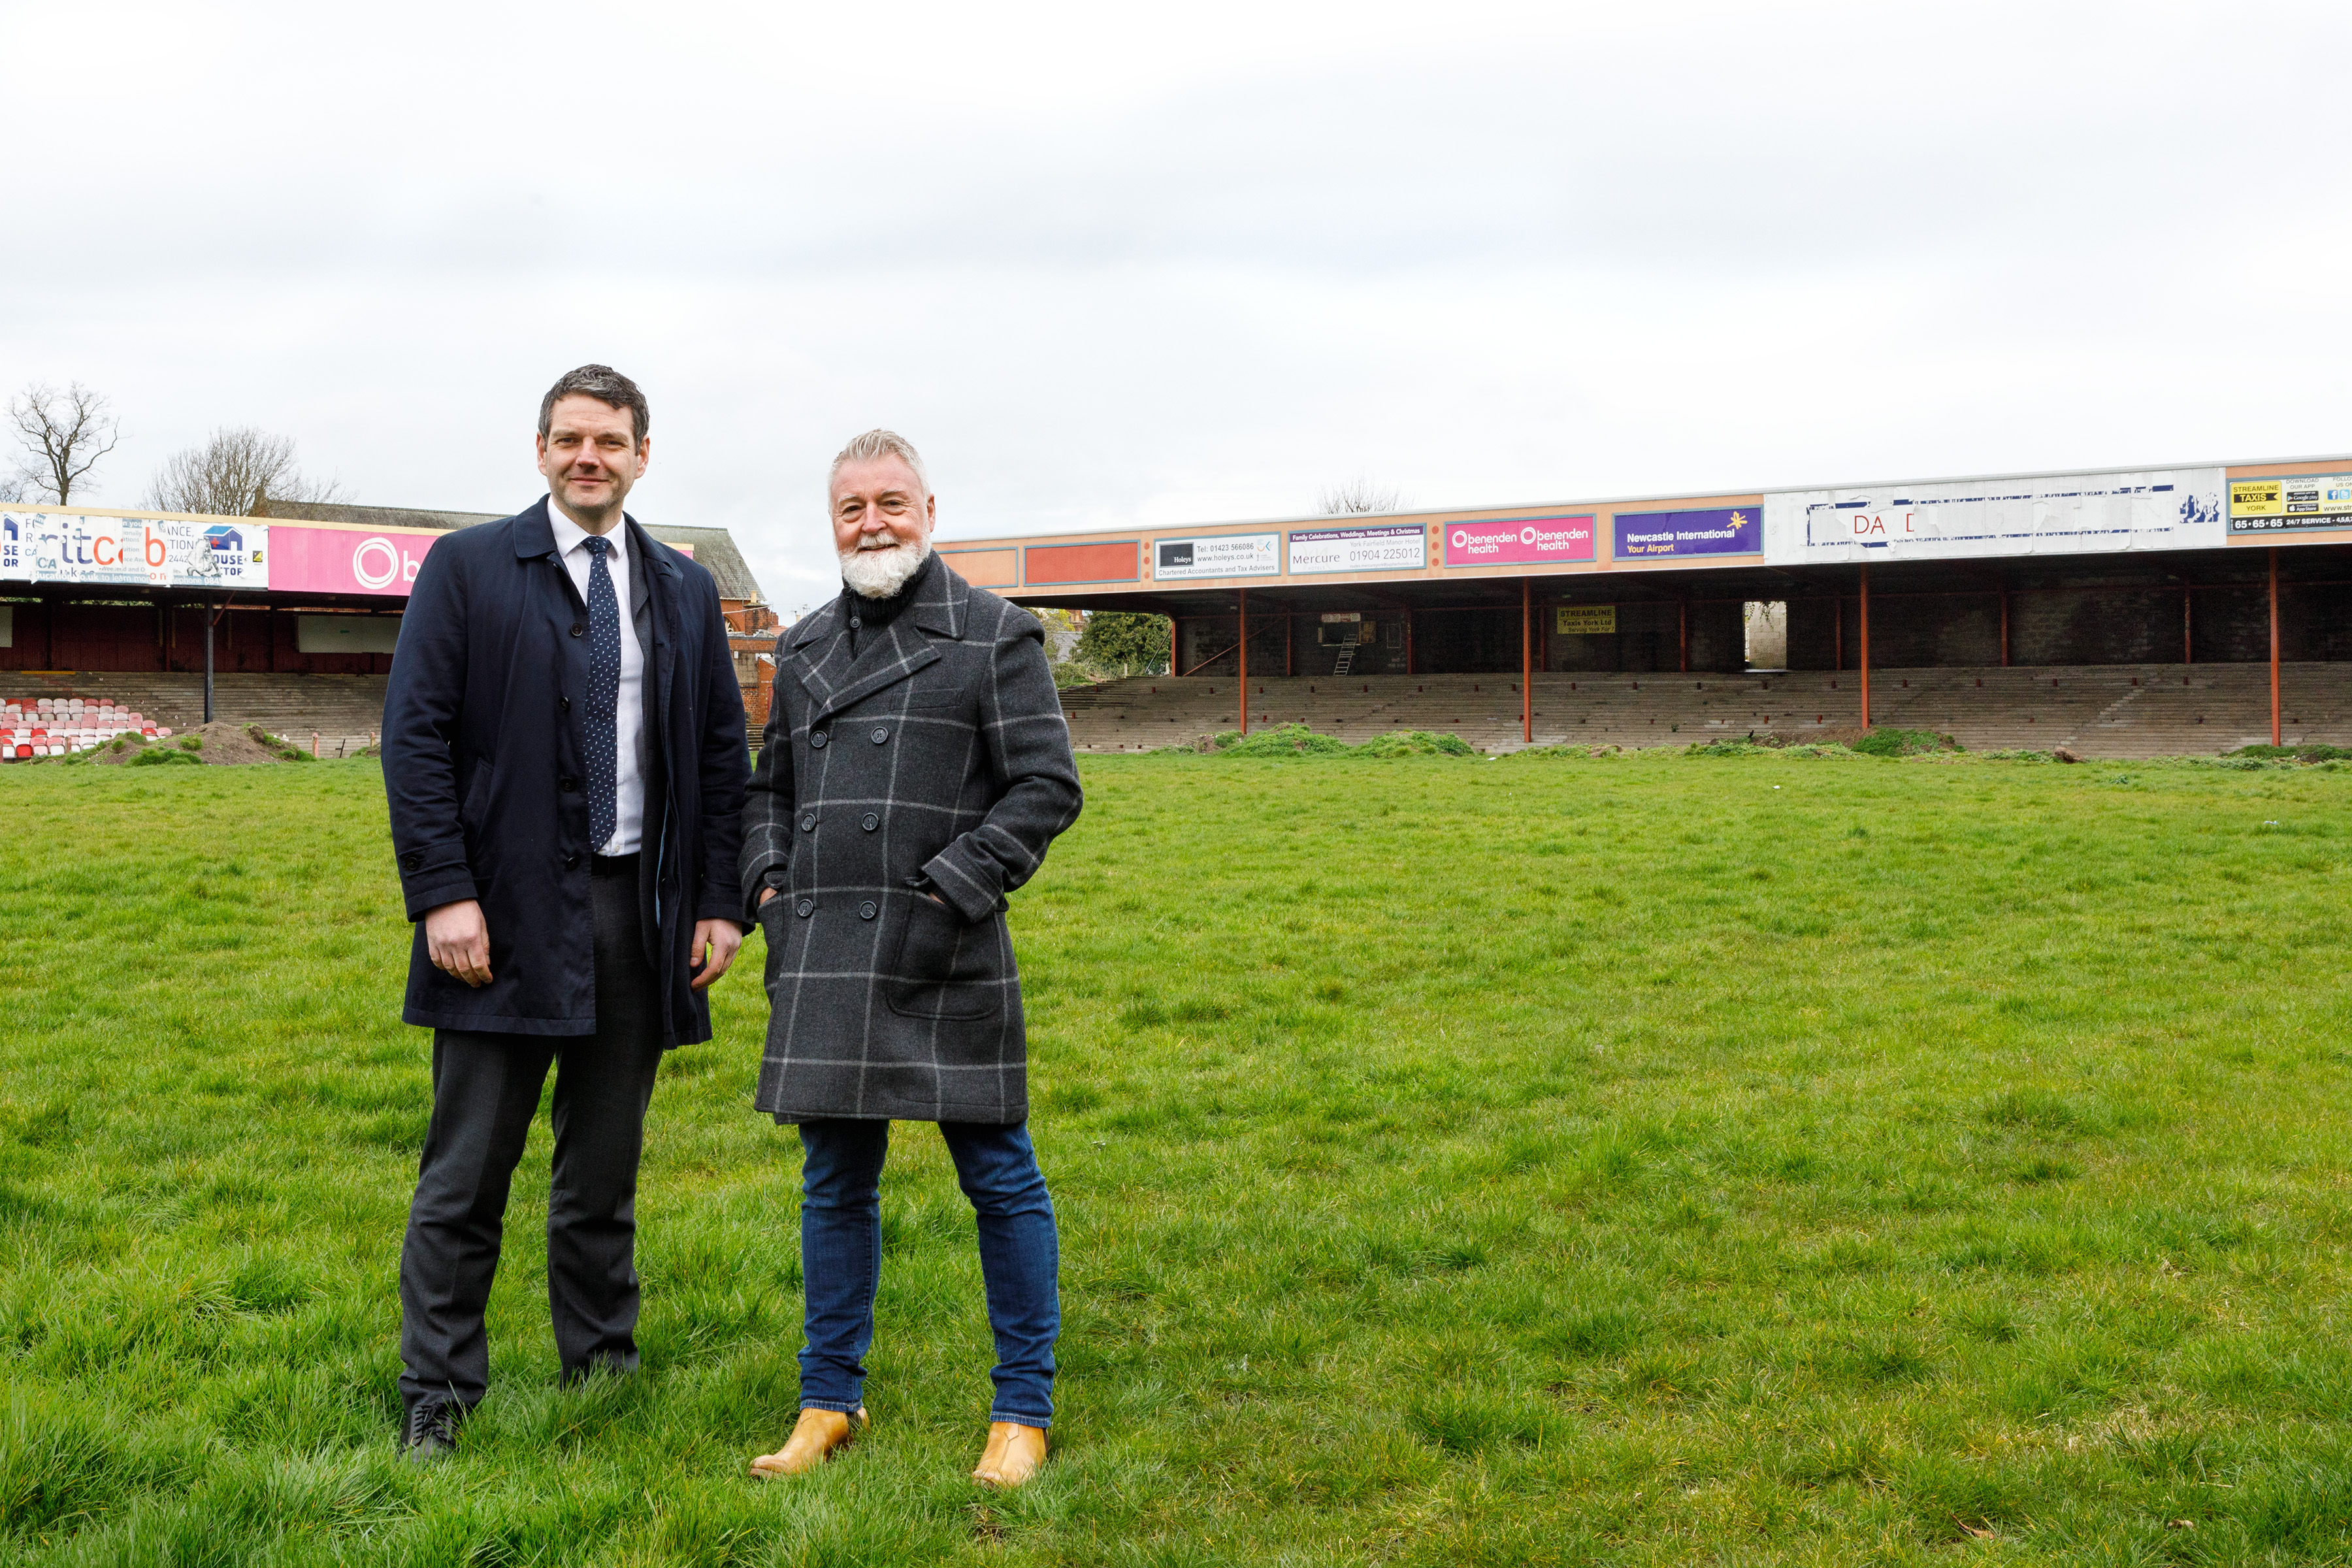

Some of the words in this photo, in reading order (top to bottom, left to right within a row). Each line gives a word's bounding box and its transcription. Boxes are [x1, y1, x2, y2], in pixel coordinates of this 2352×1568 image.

[2240, 493, 2267, 502] TAXIS
[1468, 532, 1517, 544] benenden
[1537, 528, 1588, 541] benenden
[1627, 531, 1674, 543] Newcastle
[1676, 529, 1735, 540] International
[167, 539, 194, 549] TION
[1468, 544, 1499, 554] health
[1537, 540, 1569, 551] health
[1647, 544, 1674, 553] Airport
[1197, 553, 1254, 562] www.holeys.co.uk
[1293, 554, 1340, 564] Mercure
[1350, 549, 1380, 561] 01904
[1383, 547, 1420, 559] 225012
